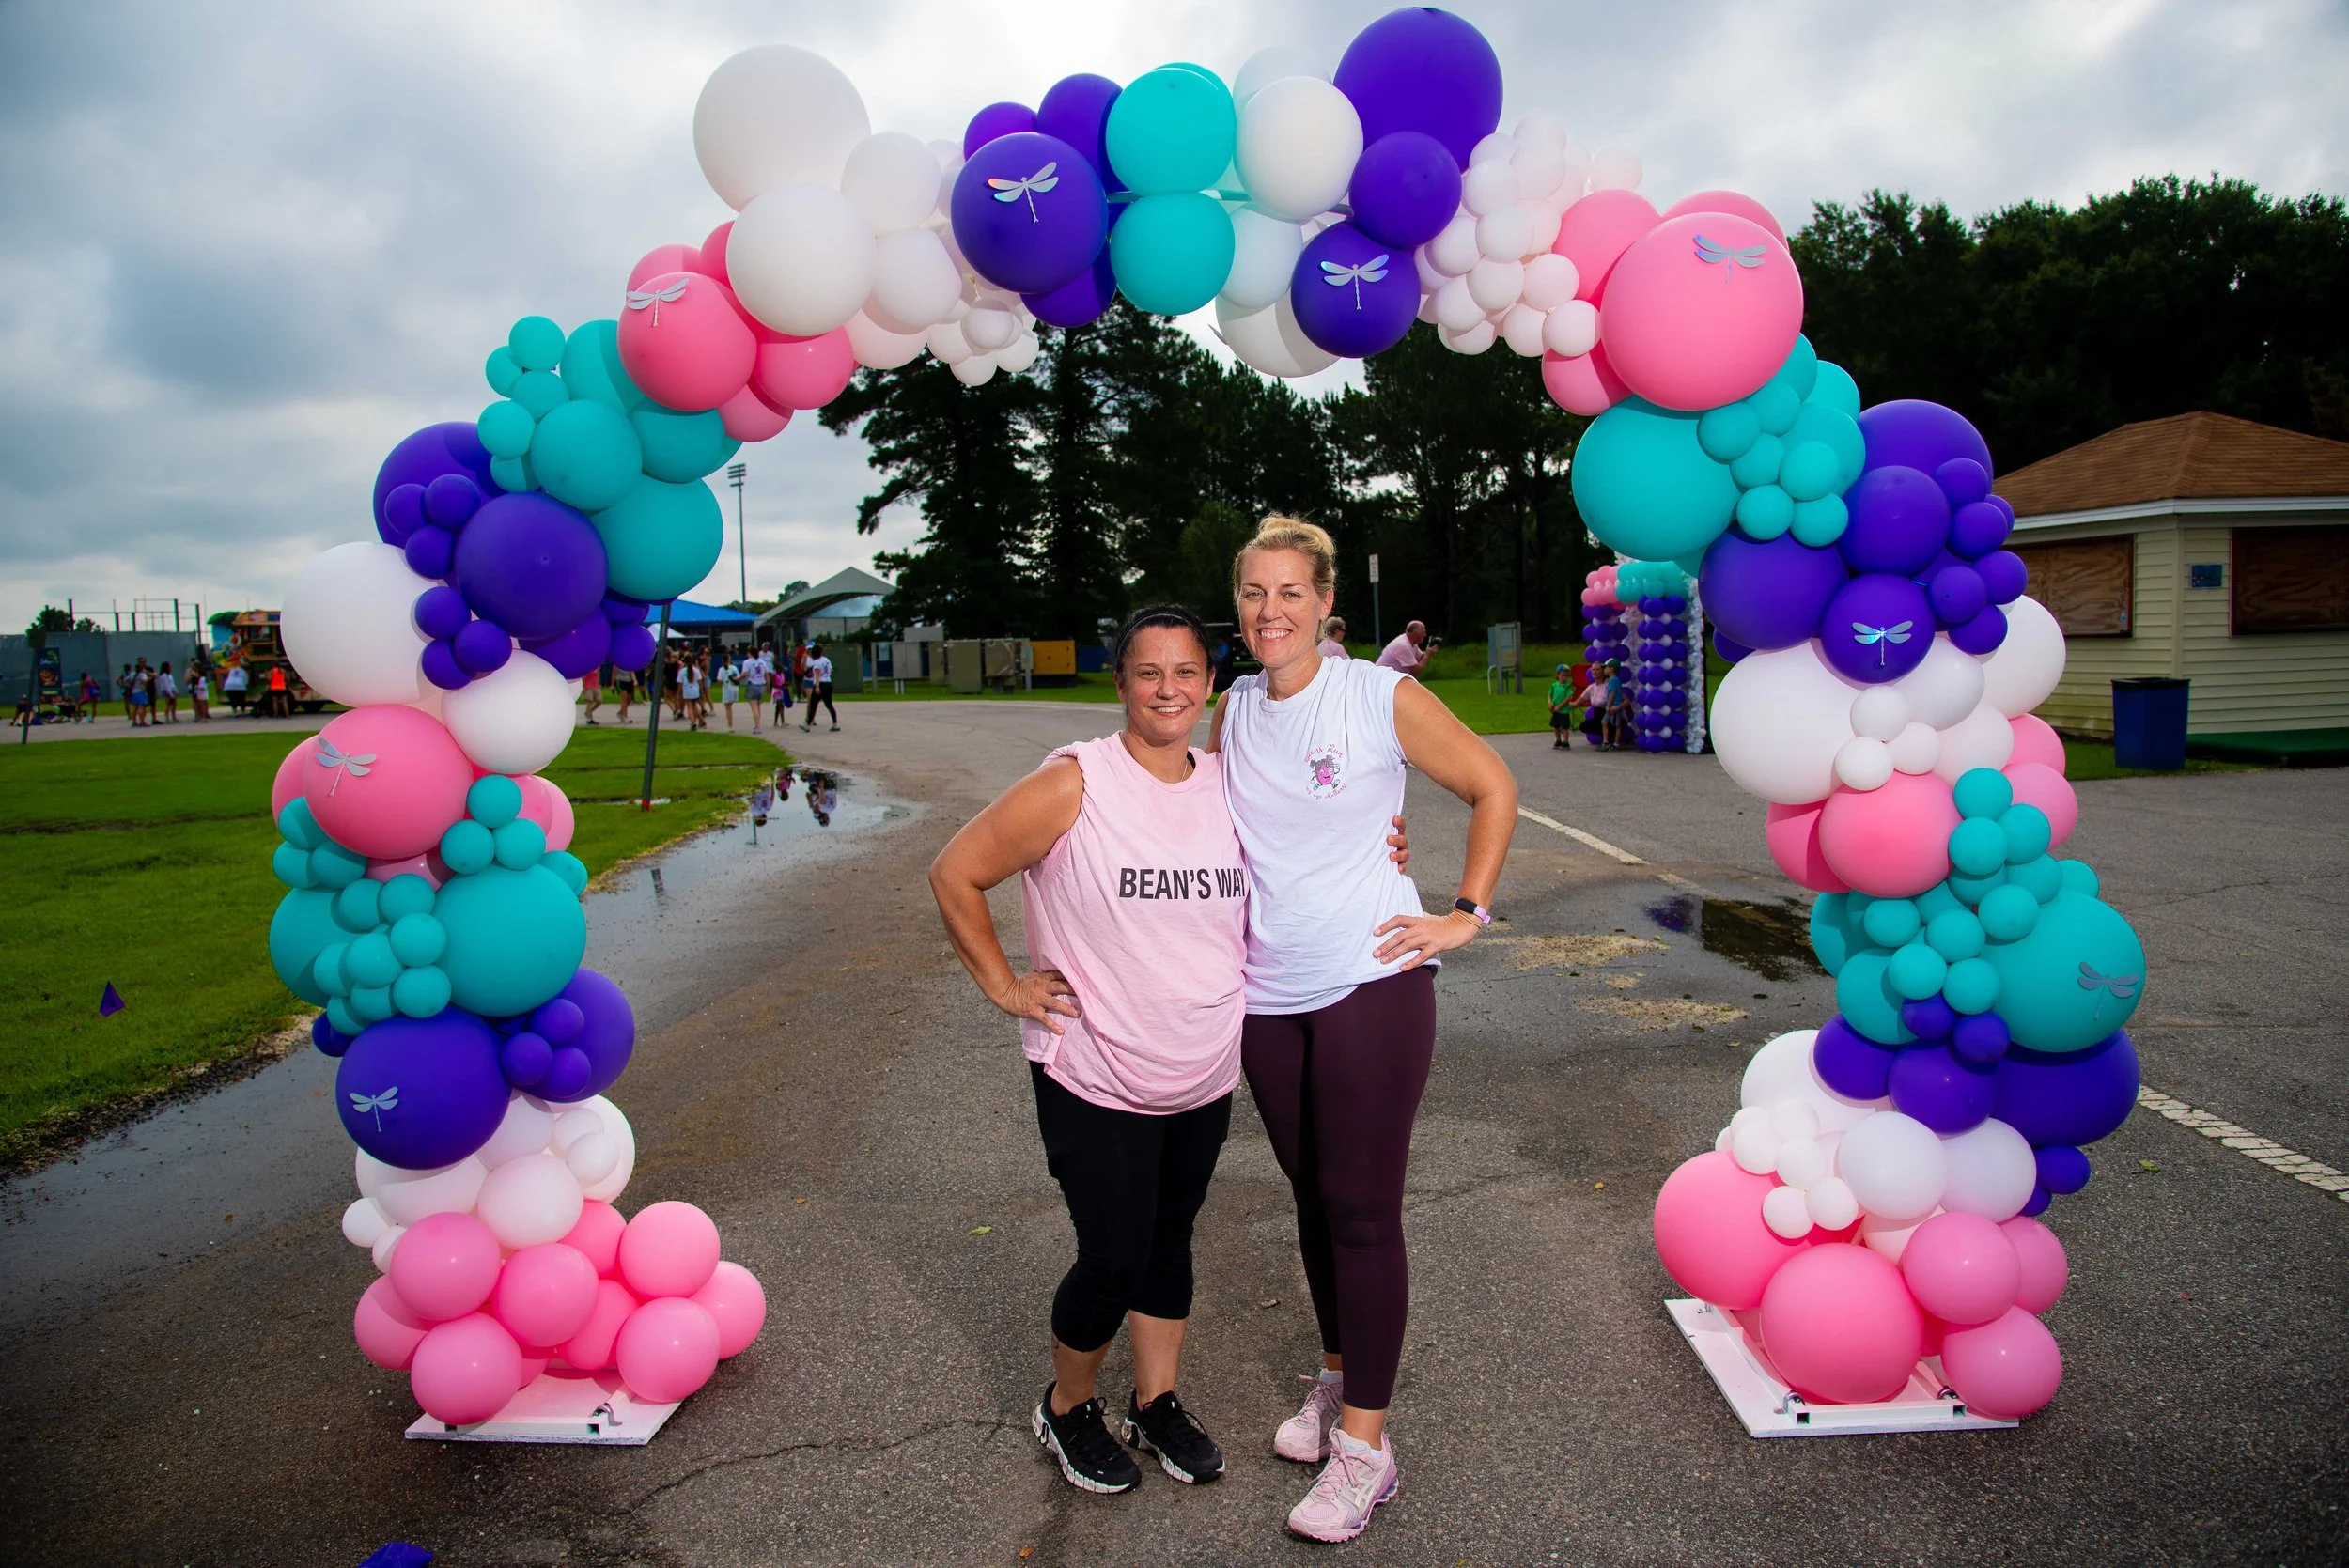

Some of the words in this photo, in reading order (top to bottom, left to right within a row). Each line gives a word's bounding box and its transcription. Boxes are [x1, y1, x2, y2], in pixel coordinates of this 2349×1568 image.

[1326, 743, 1344, 758] Run
[1119, 867, 1212, 900] BEAN'S
[1214, 867, 1246, 899] WAY
